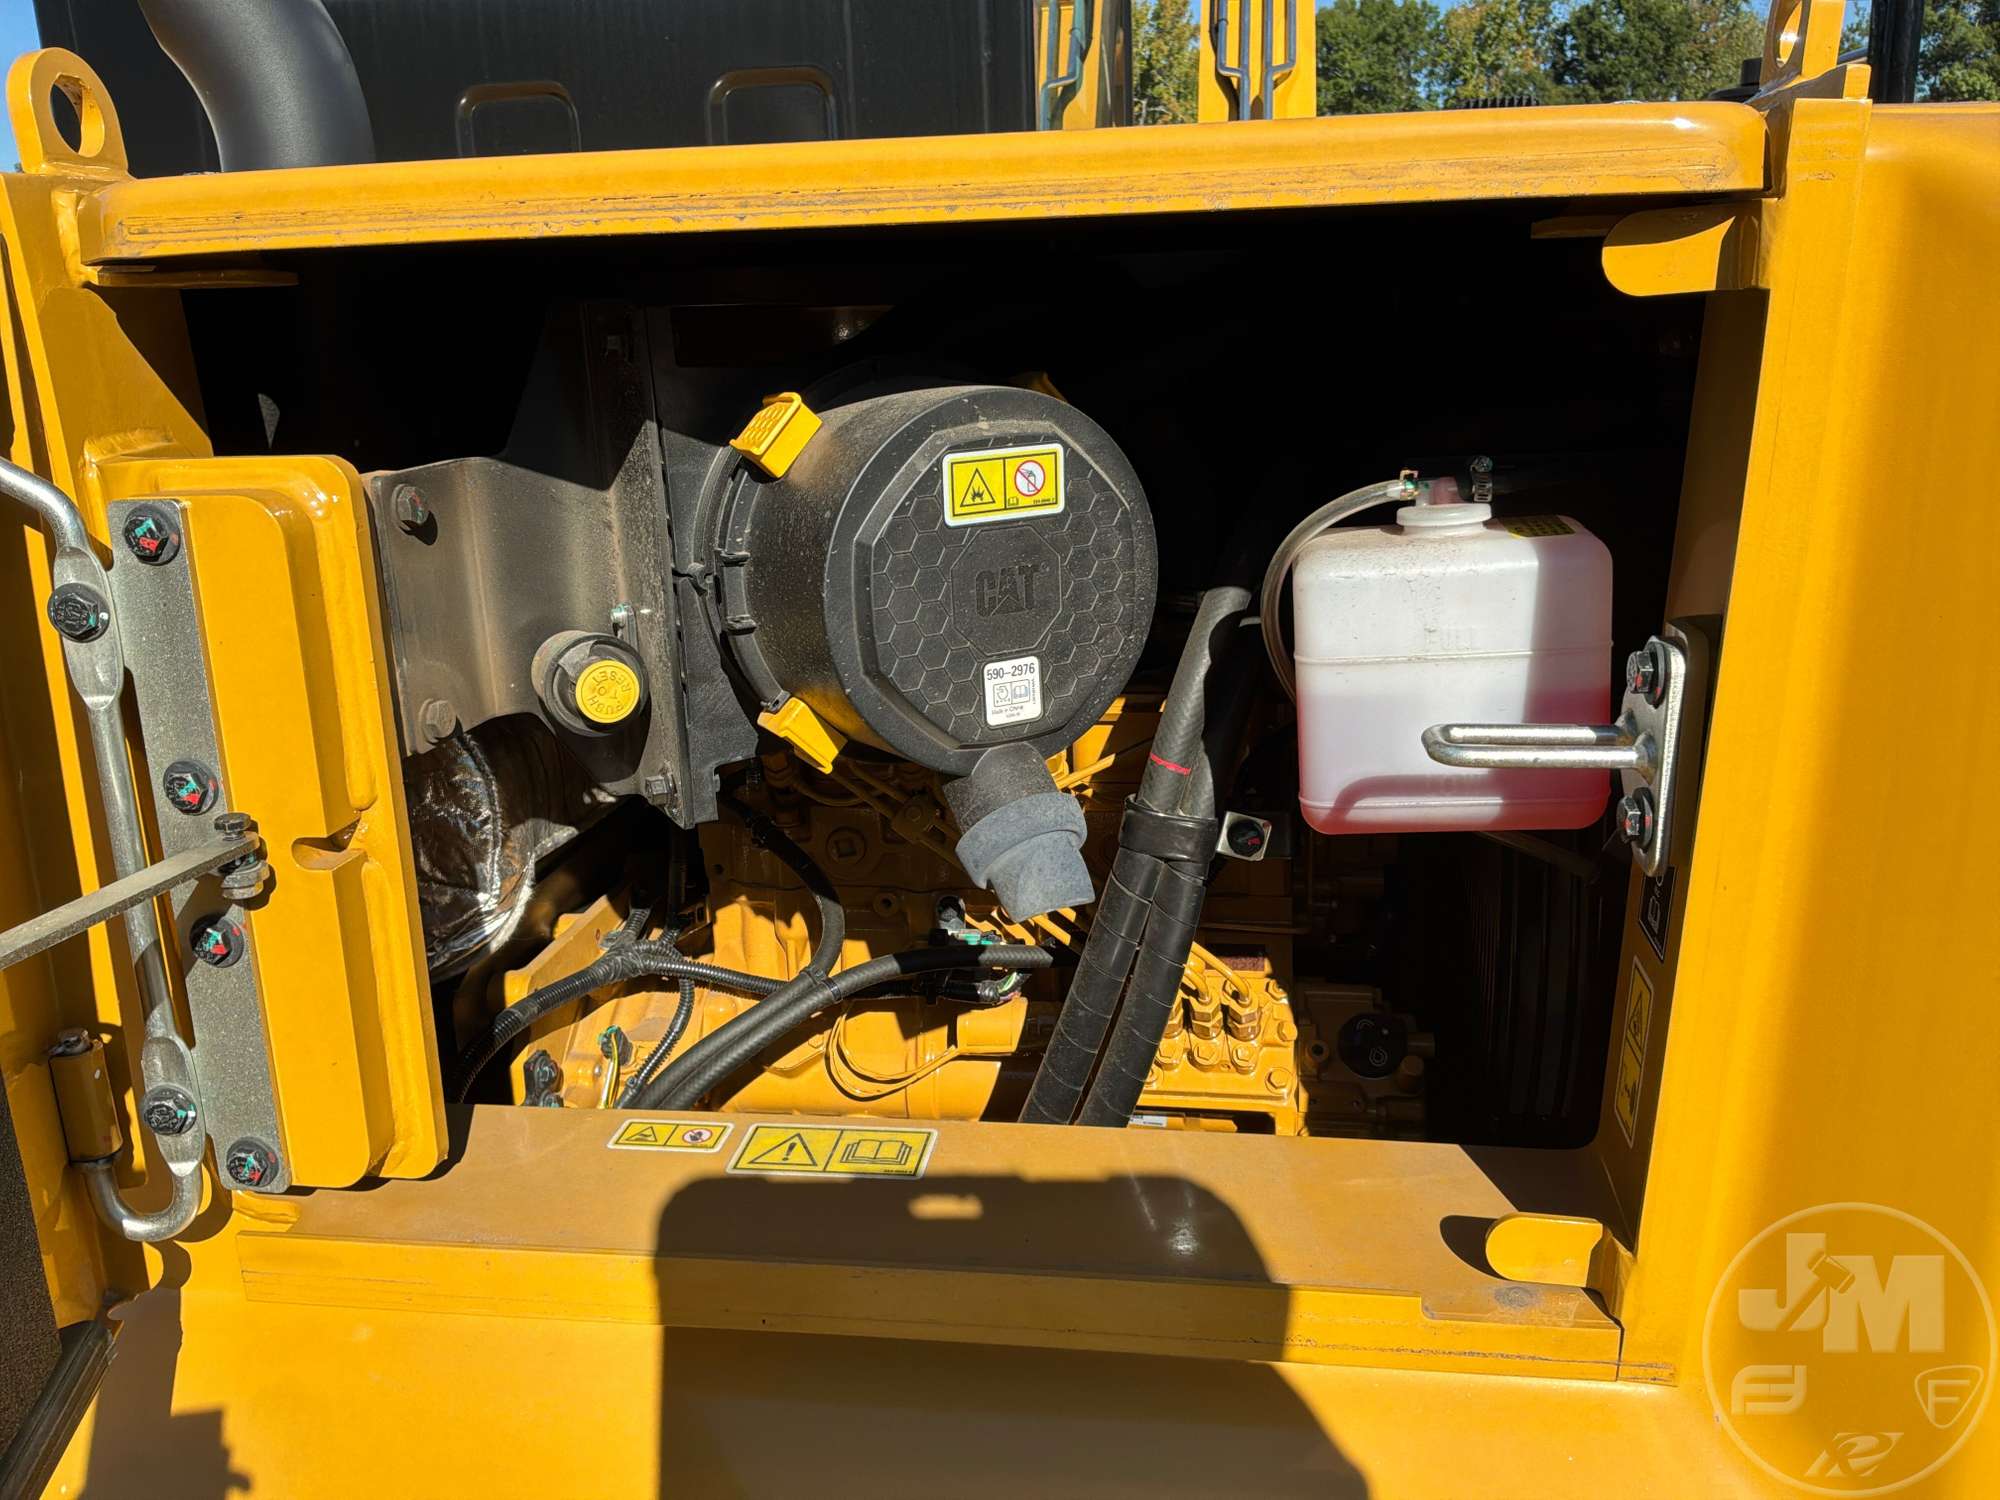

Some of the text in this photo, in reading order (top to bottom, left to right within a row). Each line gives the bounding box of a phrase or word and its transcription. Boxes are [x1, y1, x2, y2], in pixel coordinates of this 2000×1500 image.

[976, 565, 1040, 617] CAT
[987, 663, 1035, 680] 590-2976
[592, 671, 631, 692] RESET
[598, 686, 617, 699] TO
[587, 695, 624, 714] PUSH
